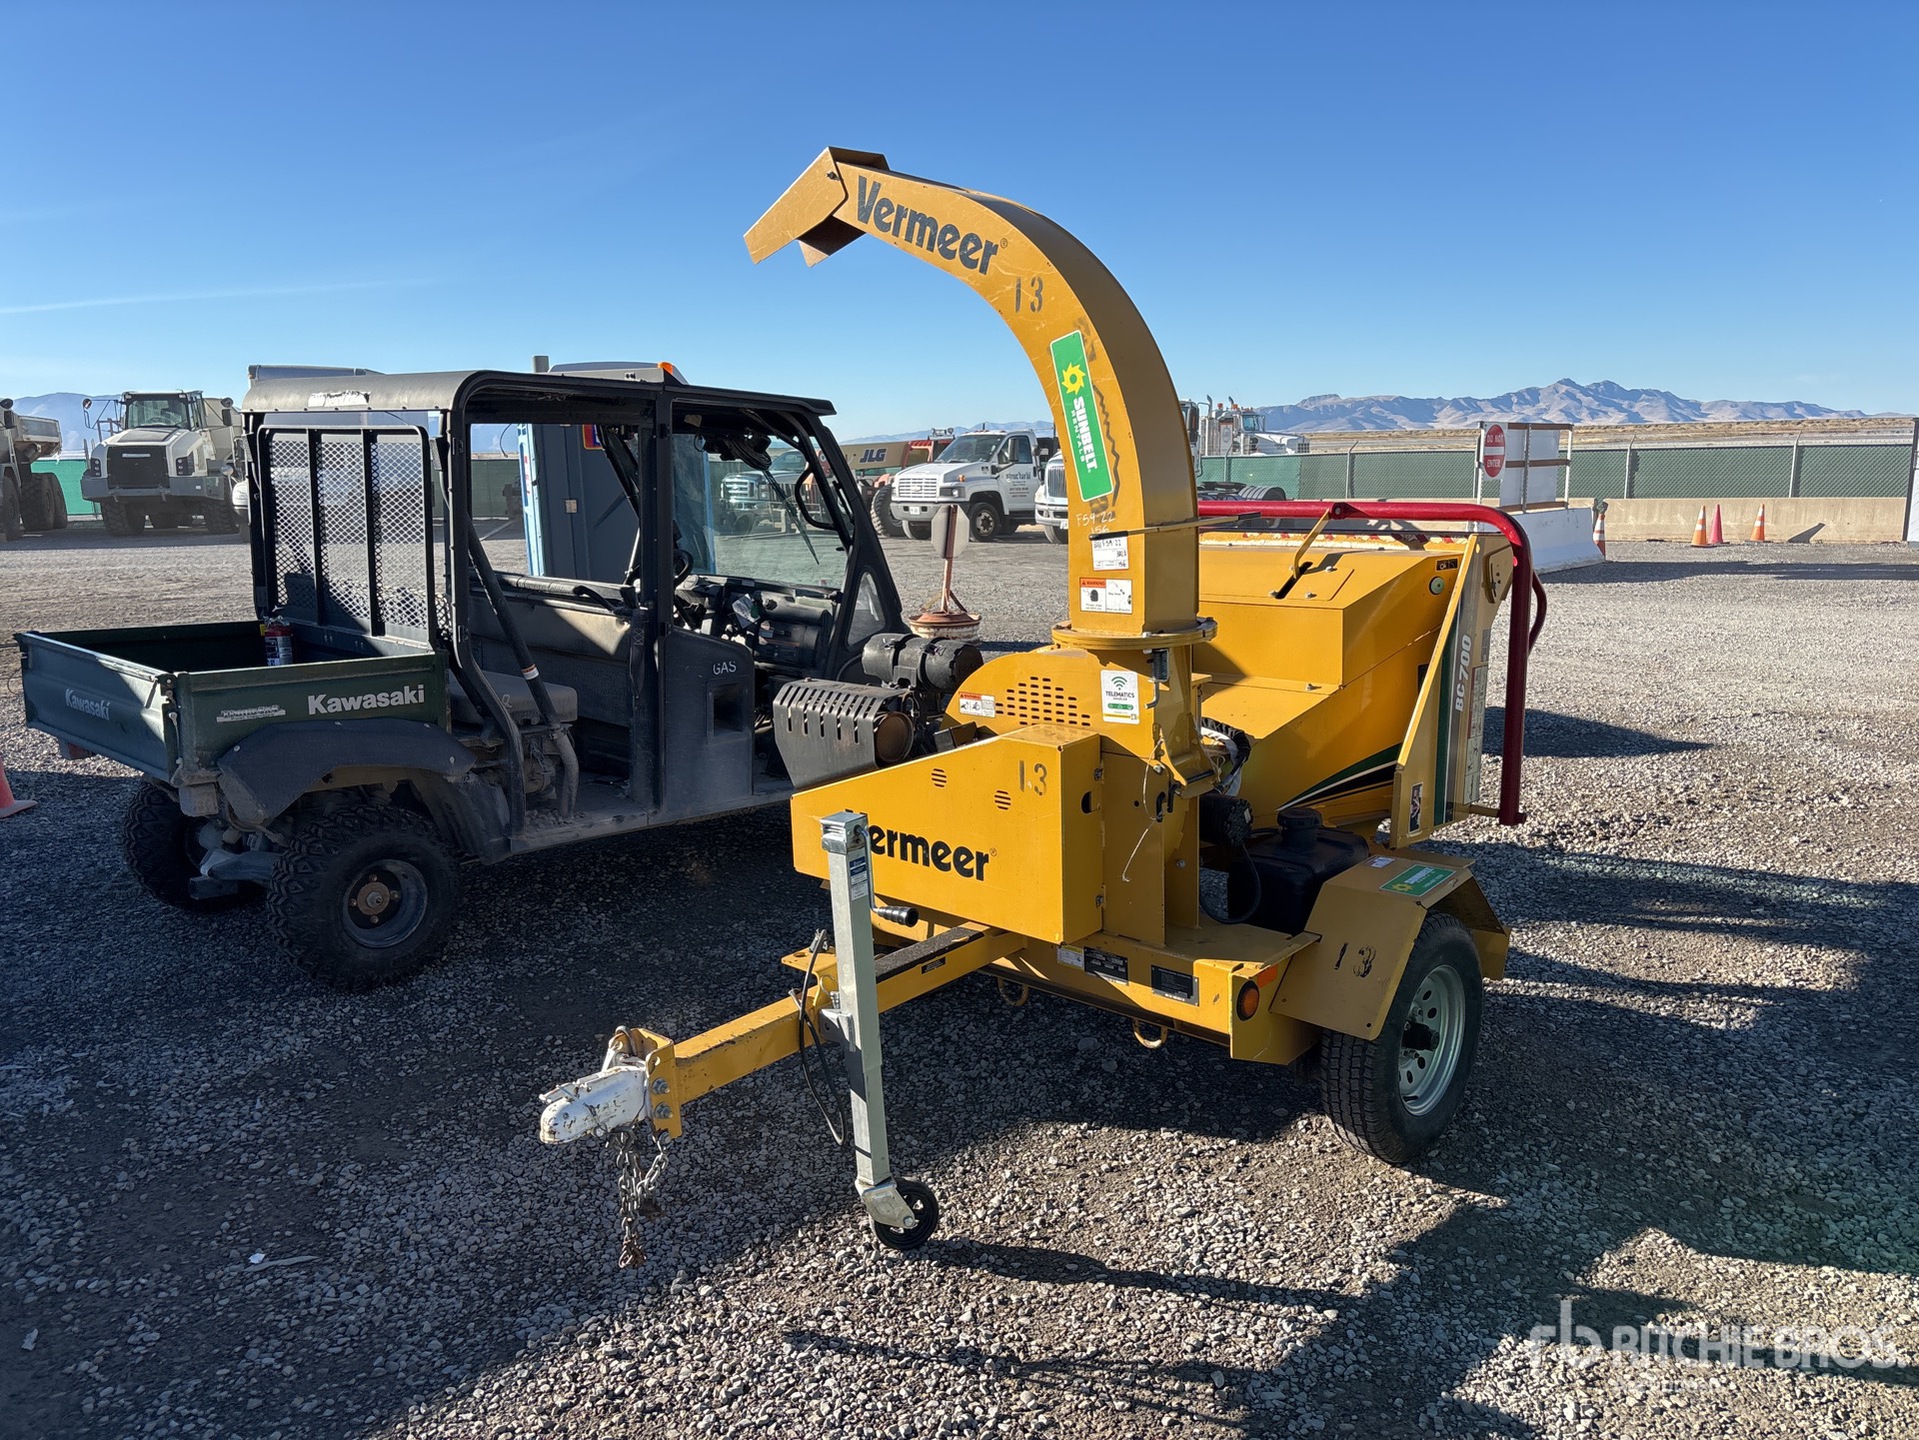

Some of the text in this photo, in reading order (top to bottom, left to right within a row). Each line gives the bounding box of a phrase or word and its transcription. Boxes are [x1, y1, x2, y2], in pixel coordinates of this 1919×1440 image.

[857, 175, 999, 276] Vermeer
[1070, 410, 1085, 463] RENTALS
[1073, 395, 1098, 473] SUNBELT
[1486, 434, 1505, 444] DO NOT
[860, 449, 887, 463] JLG
[1486, 459, 1501, 468] ENTER
[712, 660, 737, 676] GAS
[65, 688, 111, 721] Kawasaki
[307, 684, 425, 716] Kawasaki
[1105, 690, 1135, 699] TELEMATICS
[845, 809, 989, 881] ermeer
